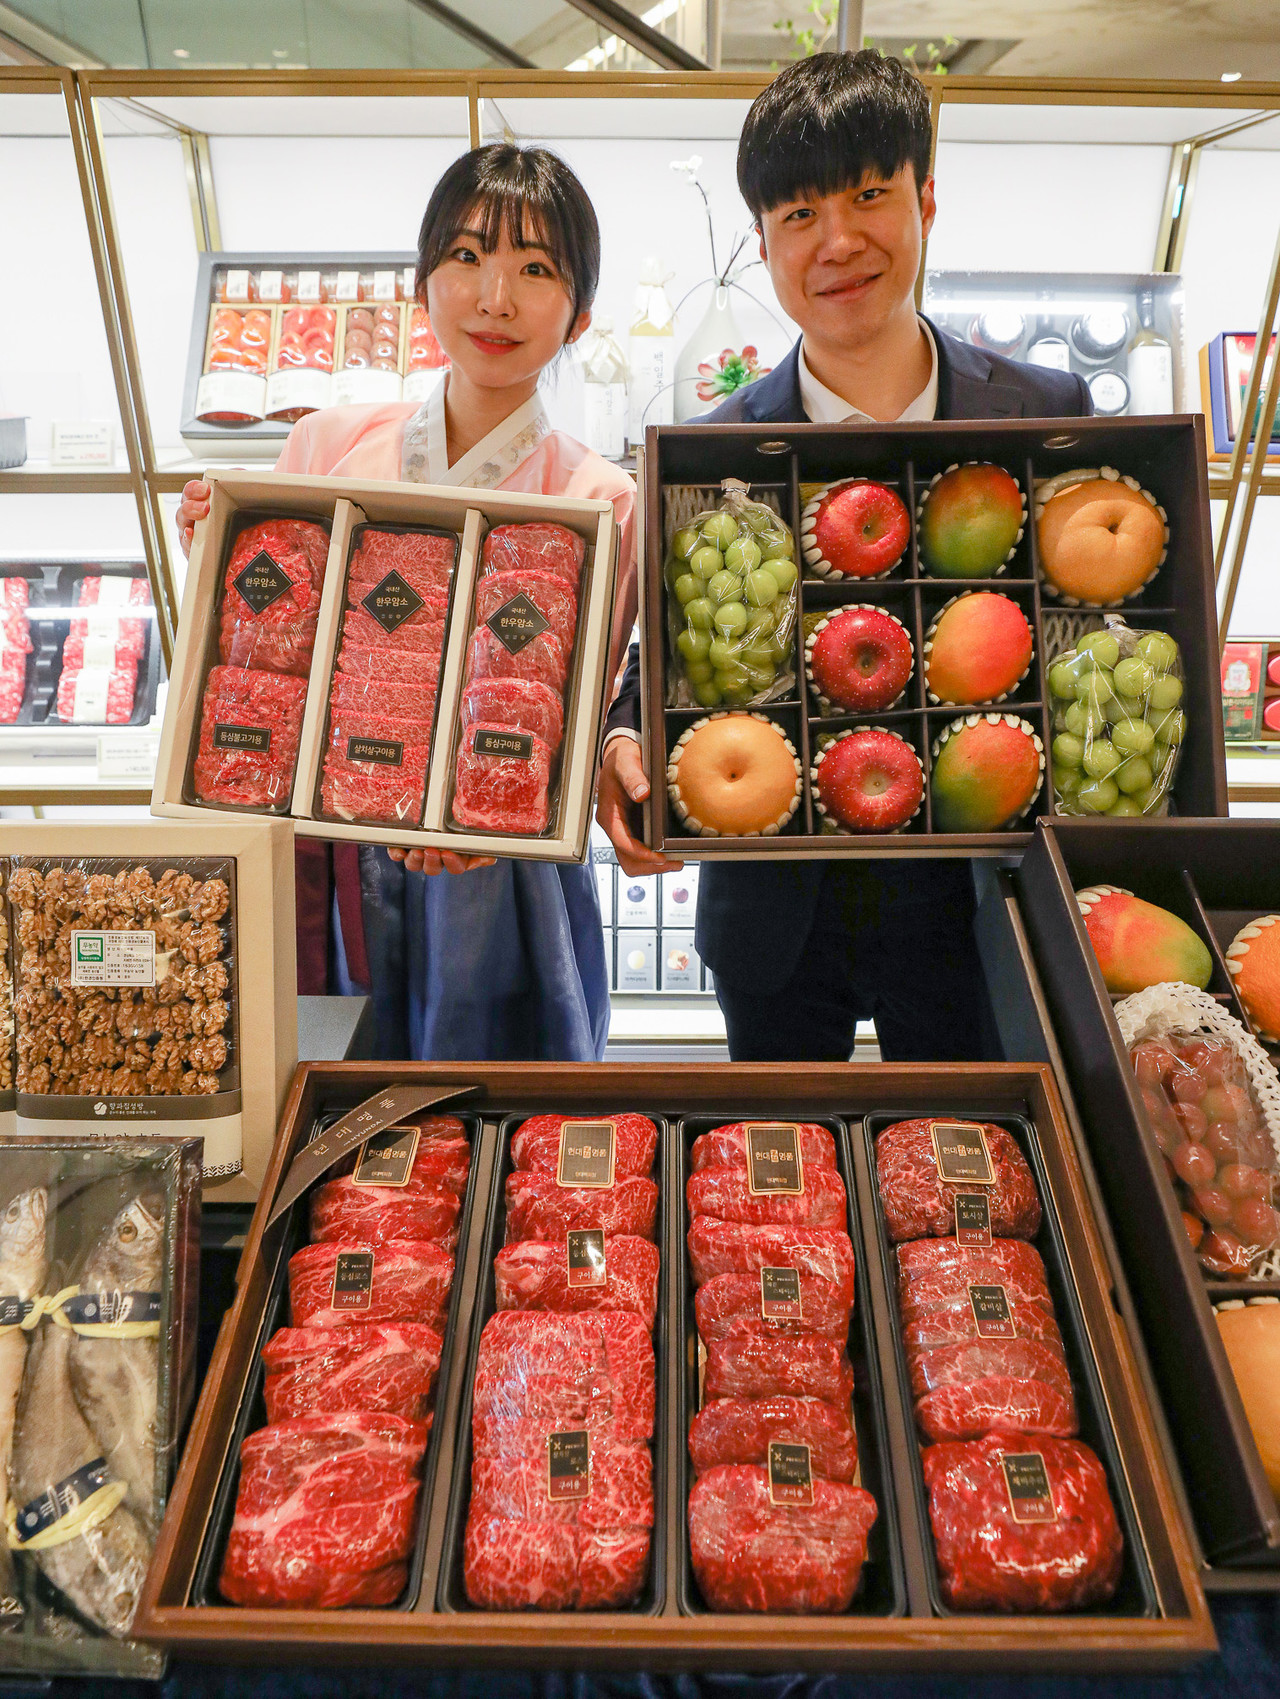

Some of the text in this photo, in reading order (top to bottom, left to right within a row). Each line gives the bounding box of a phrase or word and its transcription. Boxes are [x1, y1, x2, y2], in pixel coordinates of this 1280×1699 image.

[245, 577, 278, 588] 한우암소
[376, 596, 408, 607] 한우암소
[500, 617, 534, 628] 한우암소
[220, 731, 262, 745] 등심불고기용
[485, 737, 522, 752] 등심구이용
[354, 744, 396, 759] 살치살구이용
[350, 1118, 384, 1142] HYUNDAI
[962, 1212, 983, 1220] 토시살
[966, 1232, 984, 1240] 구이용
[342, 1295, 362, 1303] 구이용
[772, 1304, 793, 1312] 구이용
[980, 1302, 1002, 1312] 갈비살
[986, 1324, 1006, 1332] 구이용
[559, 1480, 580, 1490] 구이용
